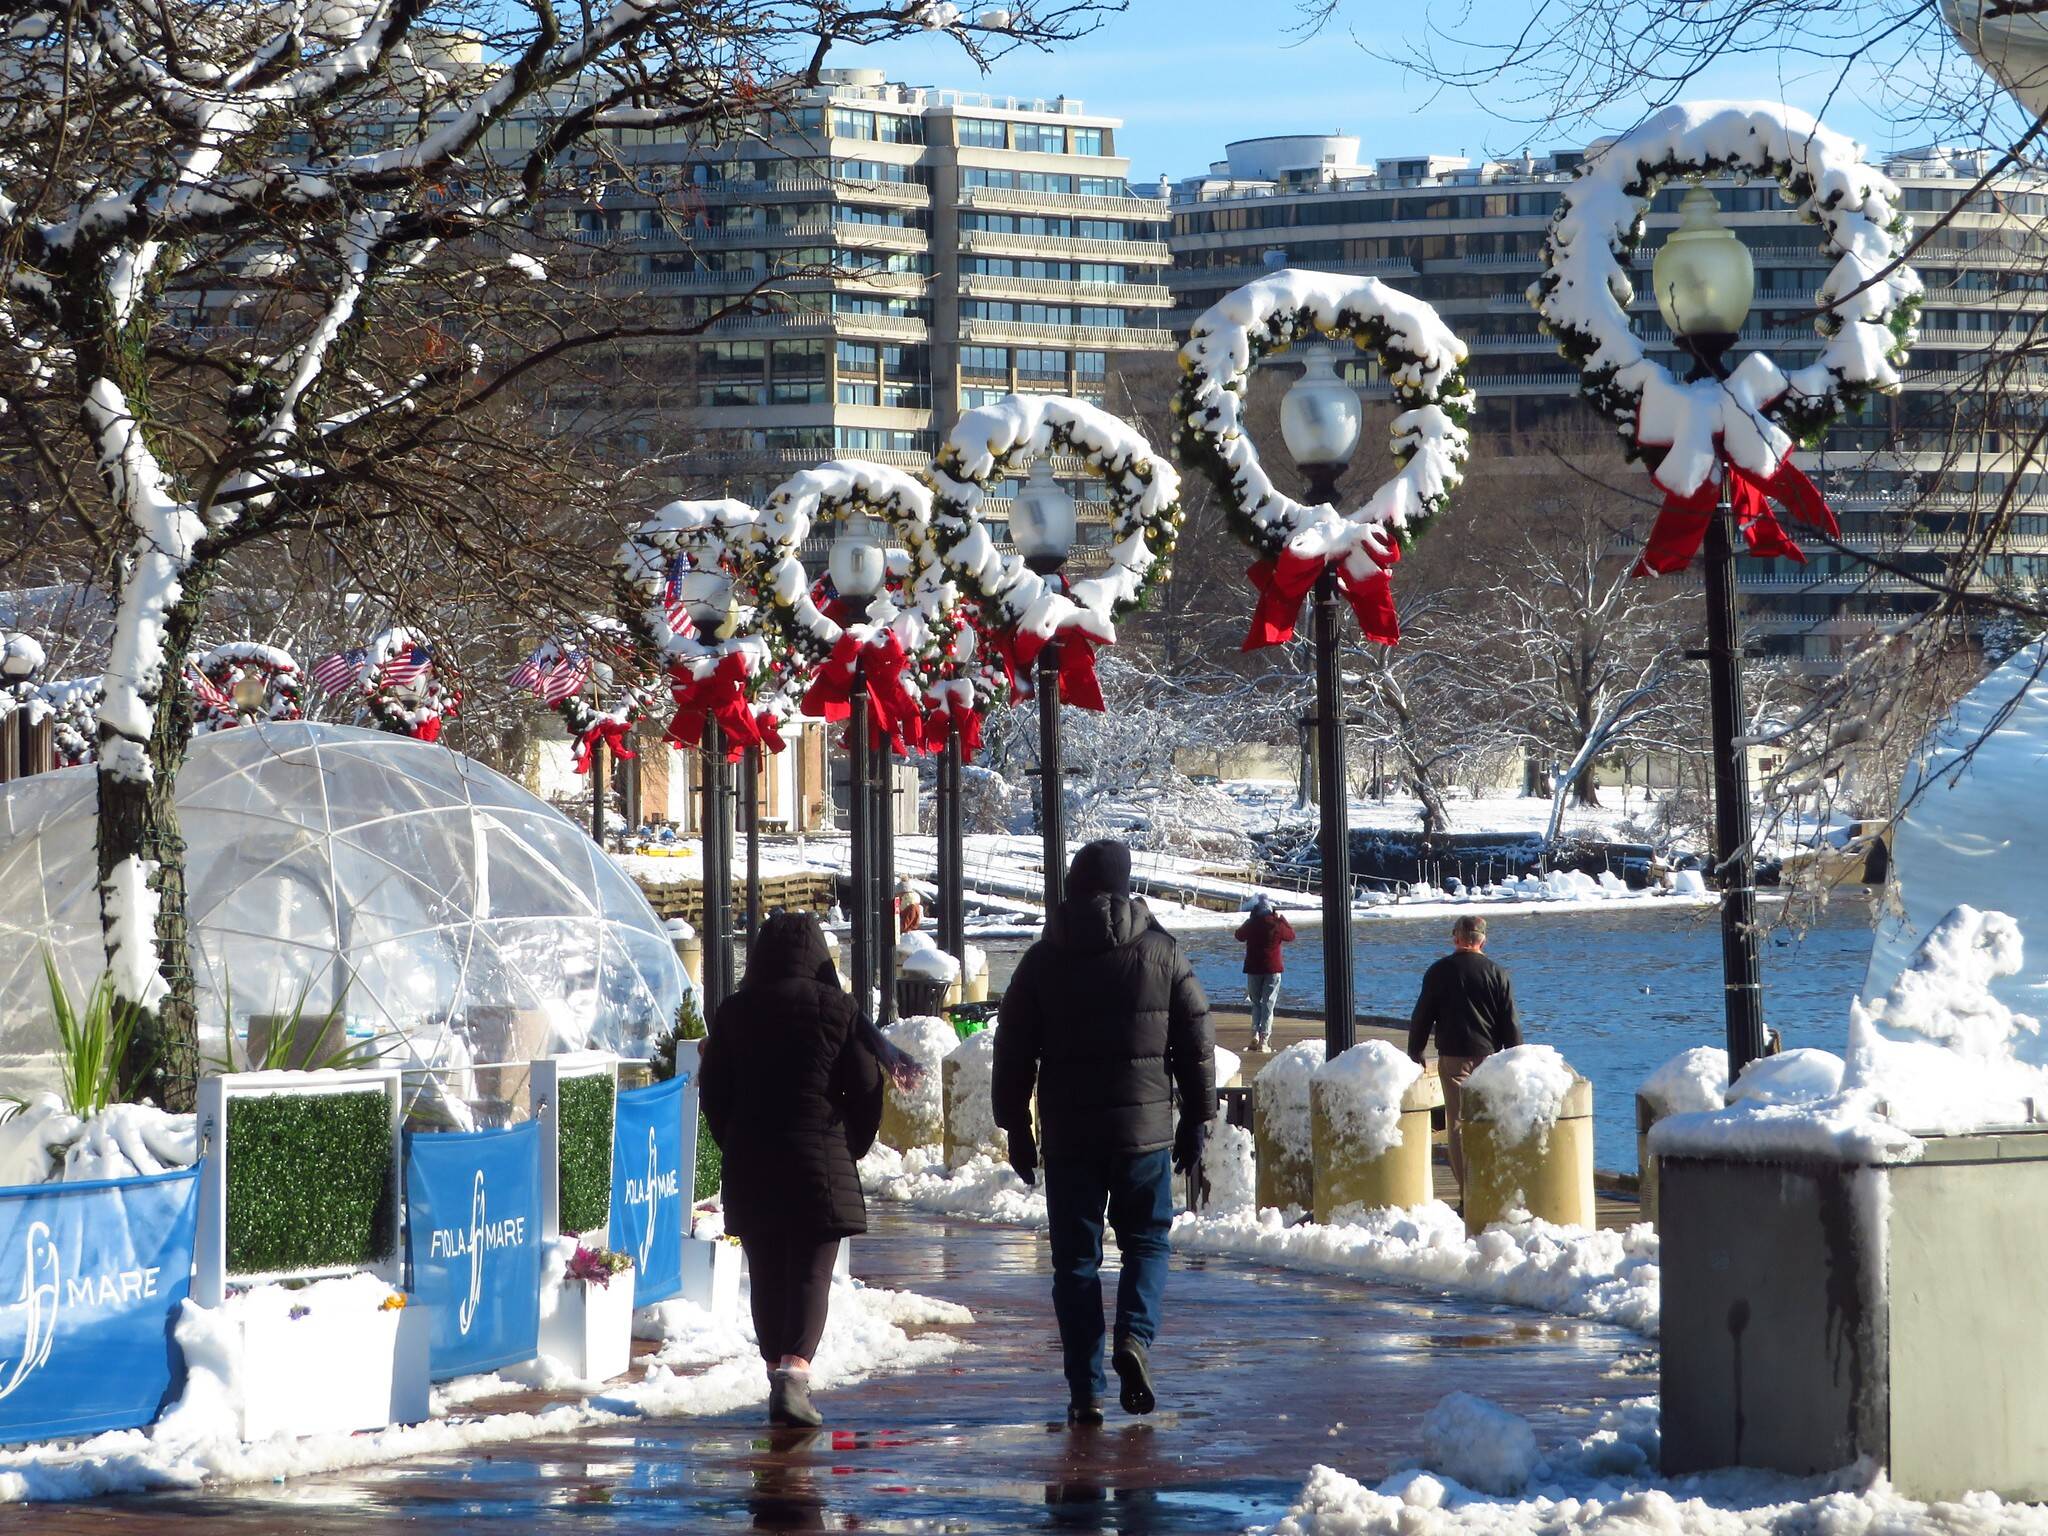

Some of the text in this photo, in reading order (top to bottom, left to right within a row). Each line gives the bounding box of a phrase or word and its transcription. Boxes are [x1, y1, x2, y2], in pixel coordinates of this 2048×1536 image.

[430, 1216, 526, 1259] FIOLA MARE
[66, 1266, 161, 1308] MARE
